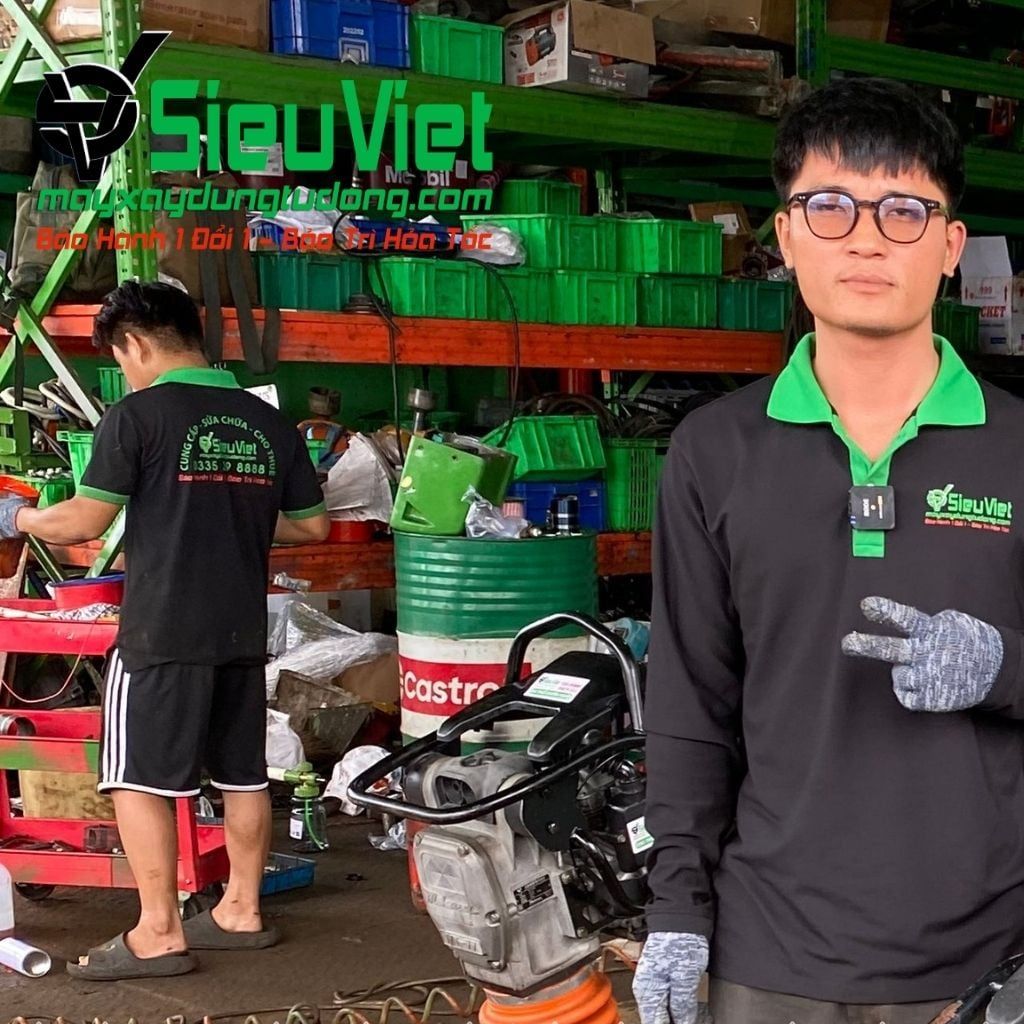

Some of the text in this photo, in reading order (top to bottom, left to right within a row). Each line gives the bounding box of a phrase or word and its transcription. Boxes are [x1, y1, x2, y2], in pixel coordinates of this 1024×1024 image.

[980, 305, 1006, 318] CKET
[180, 442, 192, 471] CUNG
[253, 429, 271, 449] CHO
[236, 462, 266, 475] 8888
[948, 492, 1012, 519] SieuViet
[404, 671, 502, 705] Castro
